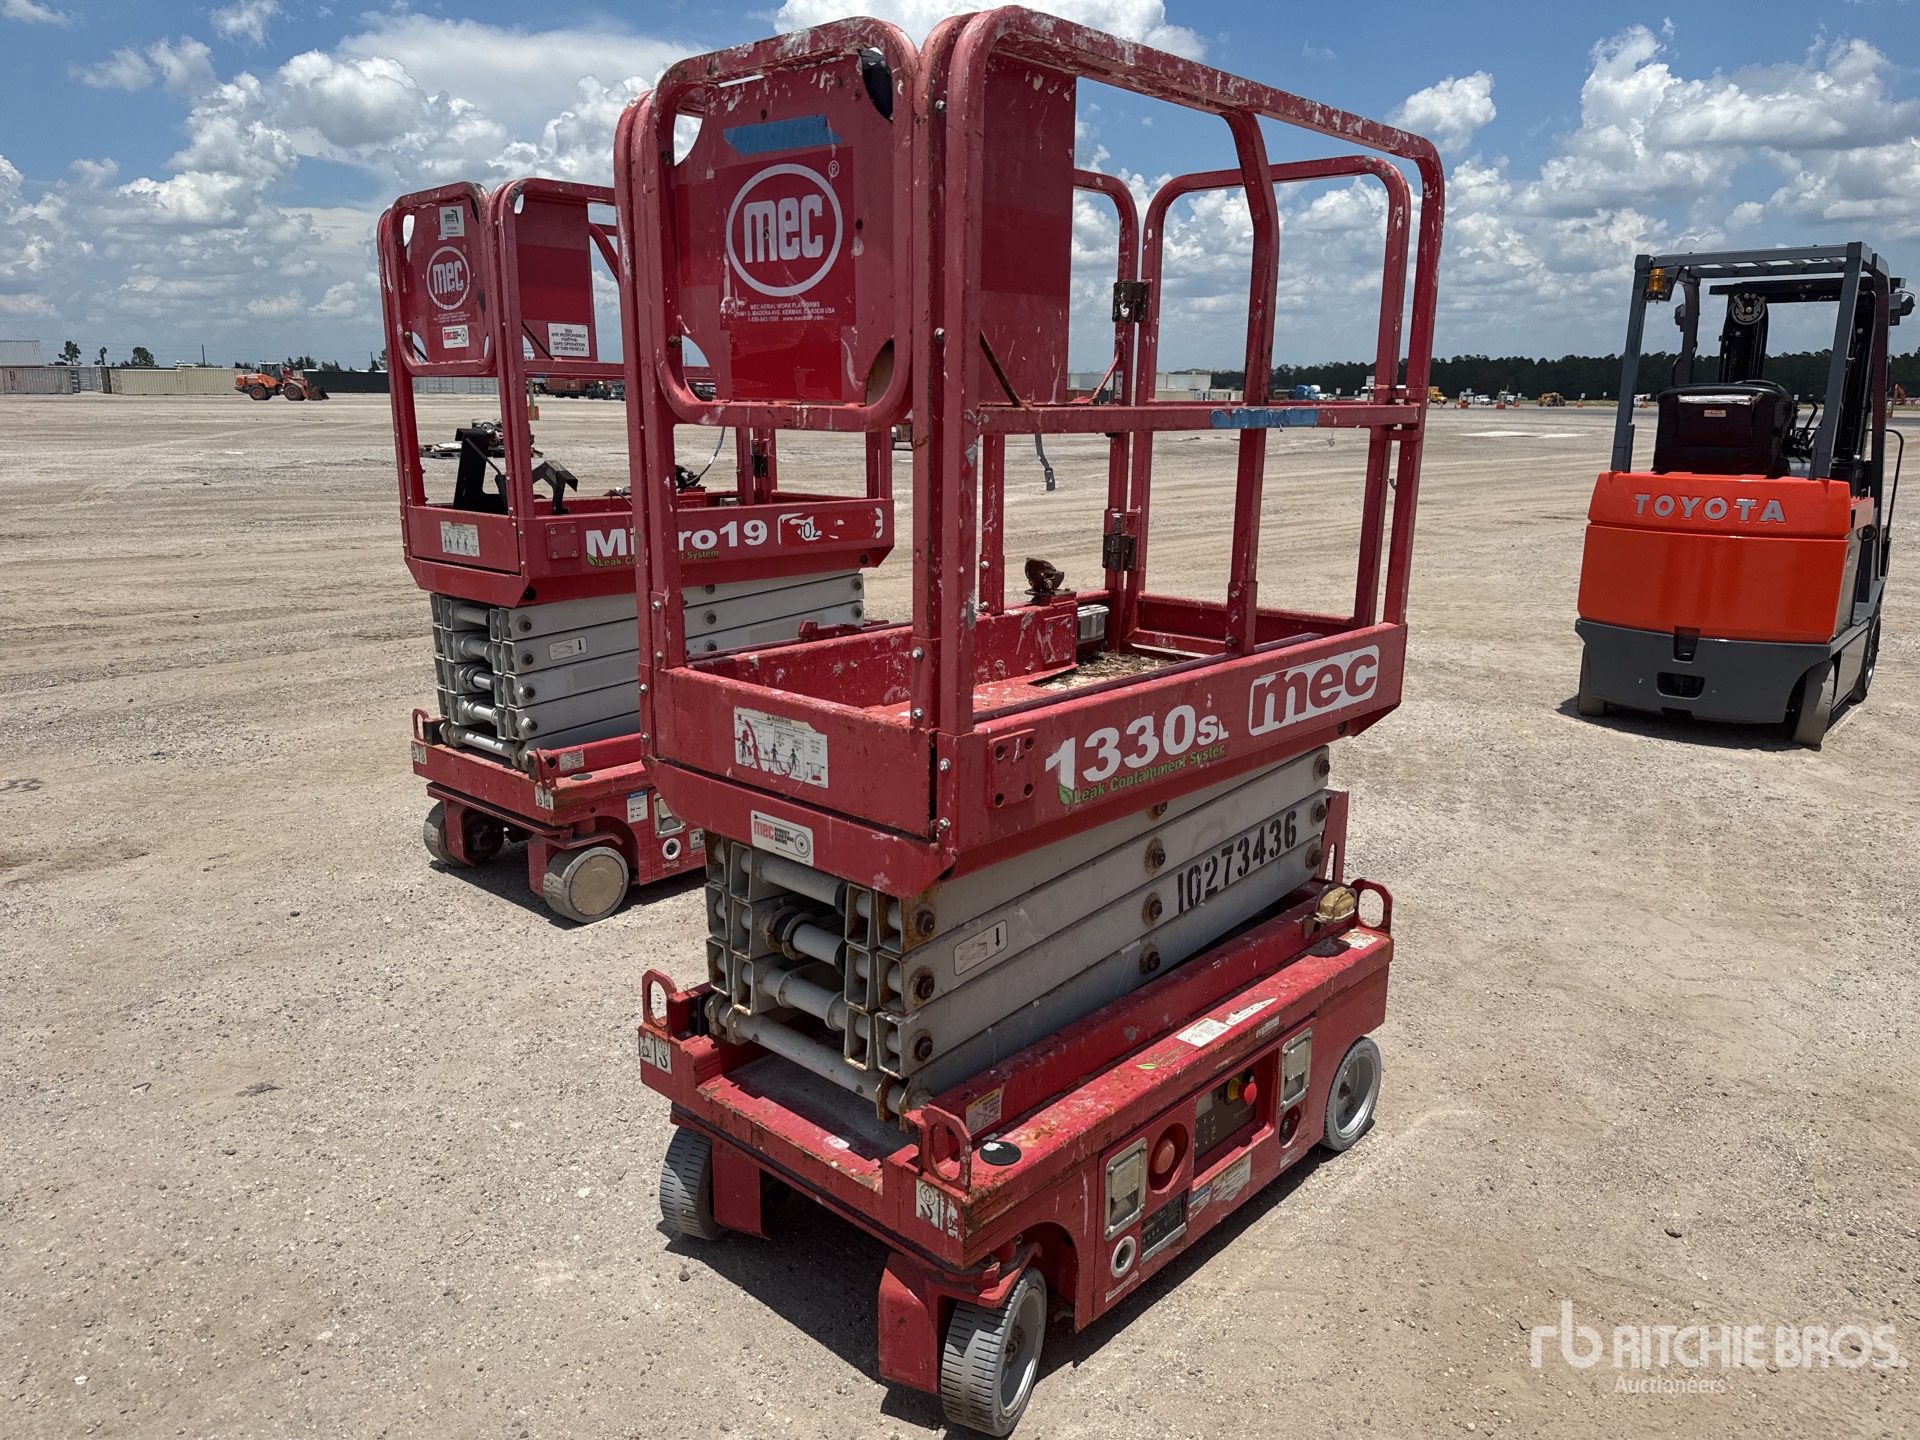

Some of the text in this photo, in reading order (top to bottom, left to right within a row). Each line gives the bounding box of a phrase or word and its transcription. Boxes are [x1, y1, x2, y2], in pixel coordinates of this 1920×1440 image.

[1634, 493, 1785, 523] TOYOTA
[585, 519, 768, 558] Miro19
[598, 557, 622, 567] Leak
[687, 549, 719, 560] System
[1073, 782, 1106, 805] Leak
[1109, 755, 1187, 792] Containment
[1177, 810, 1297, 914] 10273436
